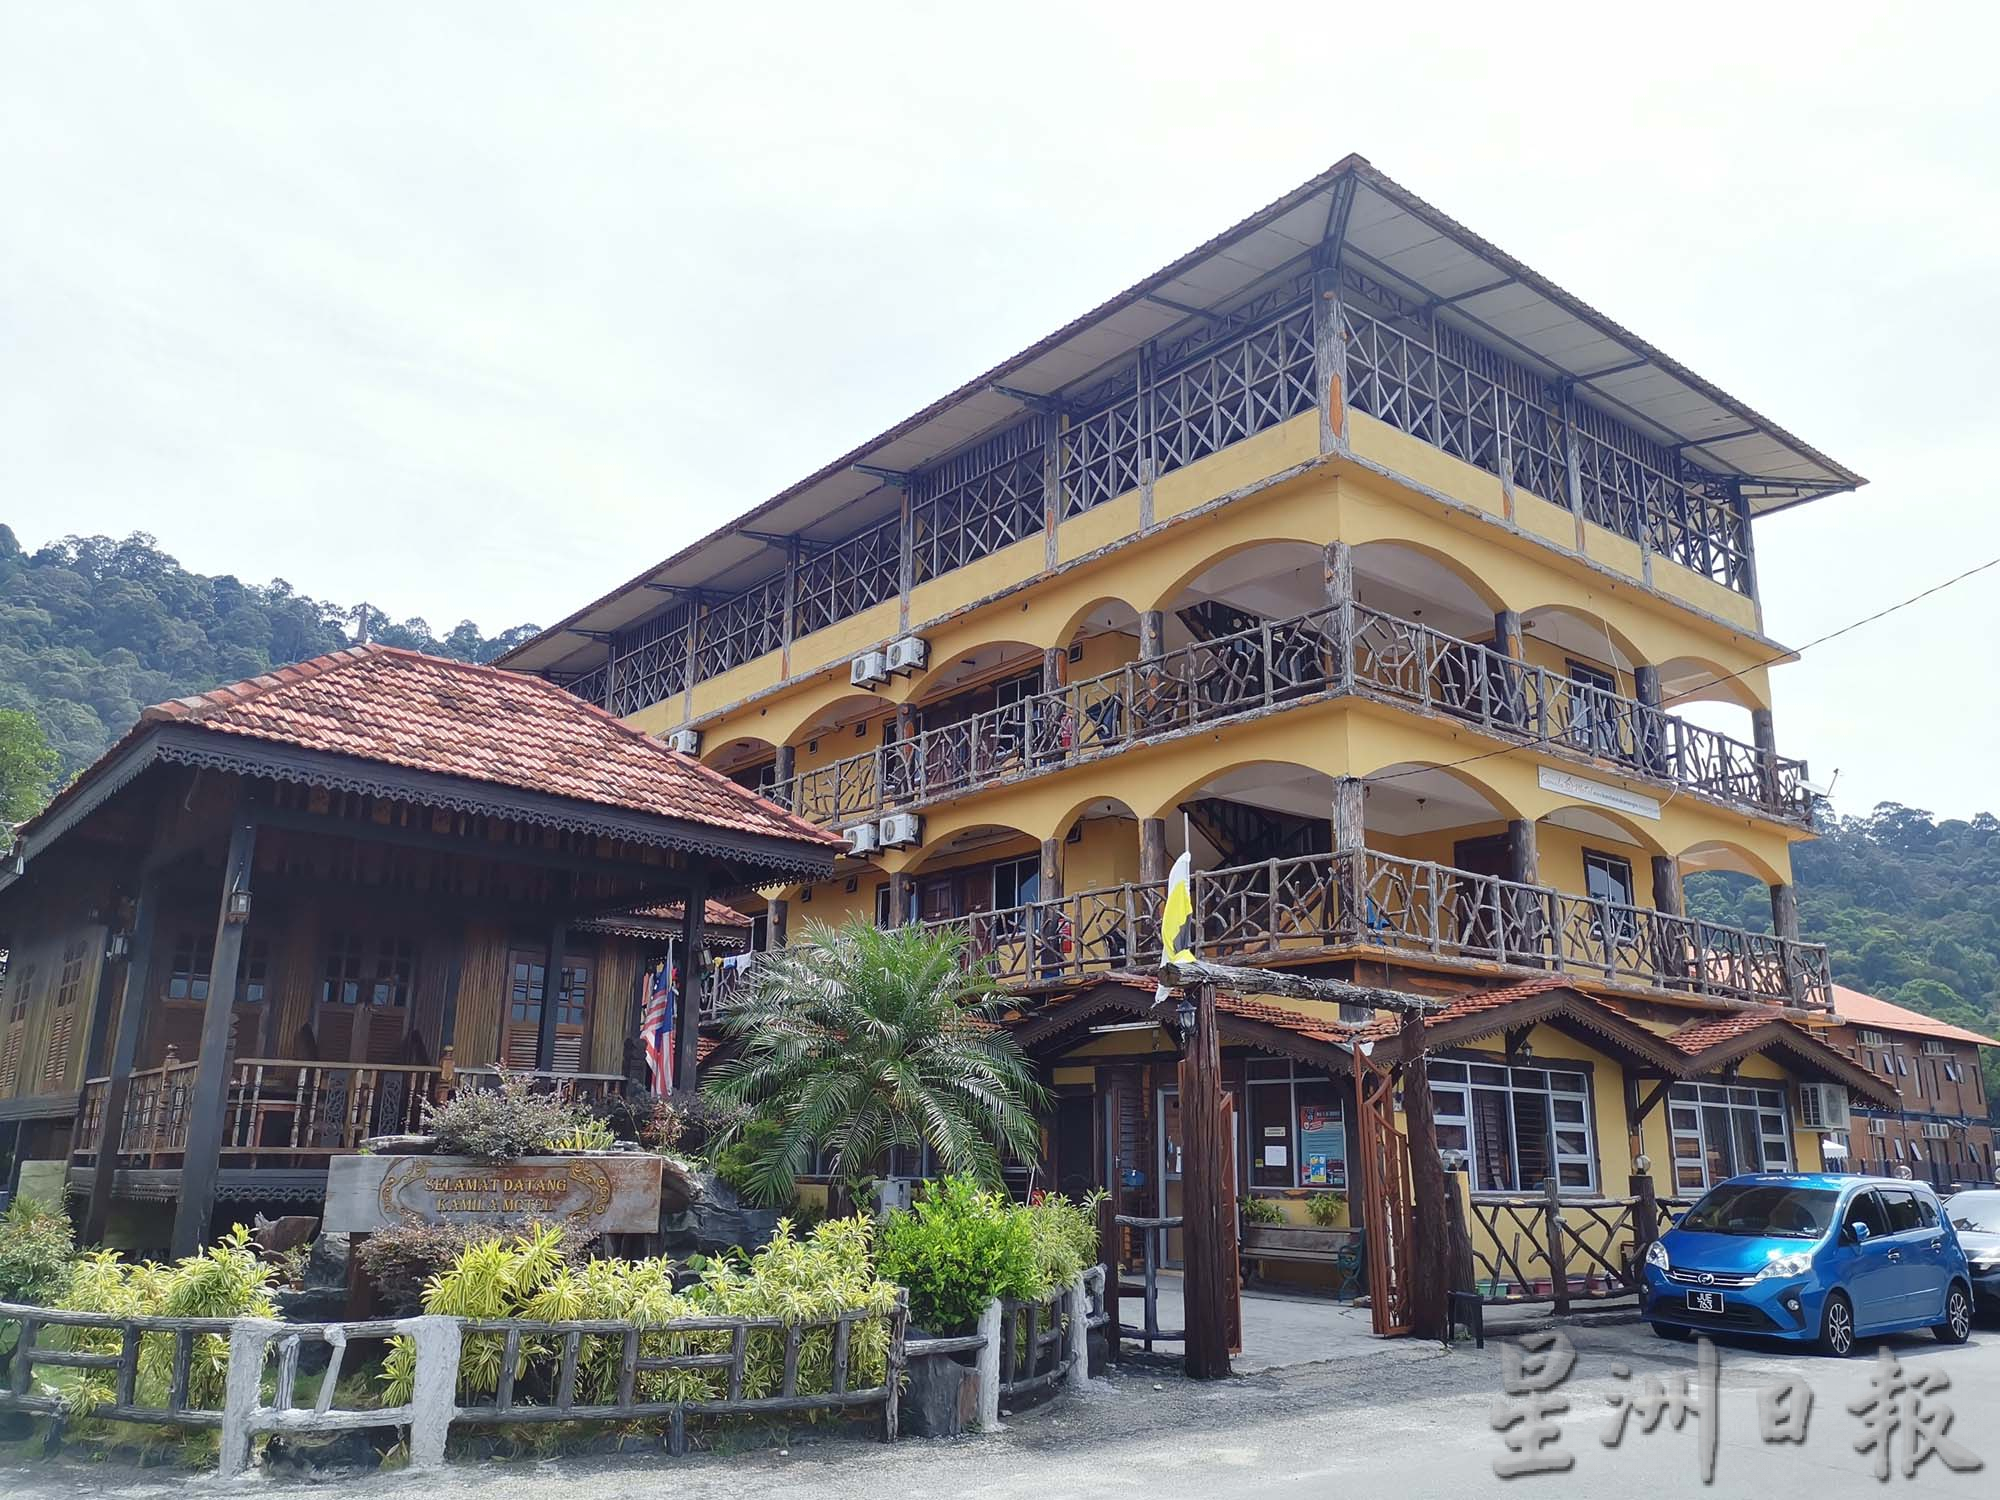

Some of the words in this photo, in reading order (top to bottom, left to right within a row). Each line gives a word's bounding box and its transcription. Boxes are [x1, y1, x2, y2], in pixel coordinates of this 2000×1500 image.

[425, 1178, 499, 1192] SELAMAT
[503, 1178, 567, 1192] DATANG
[436, 1199, 498, 1212] KAMILA
